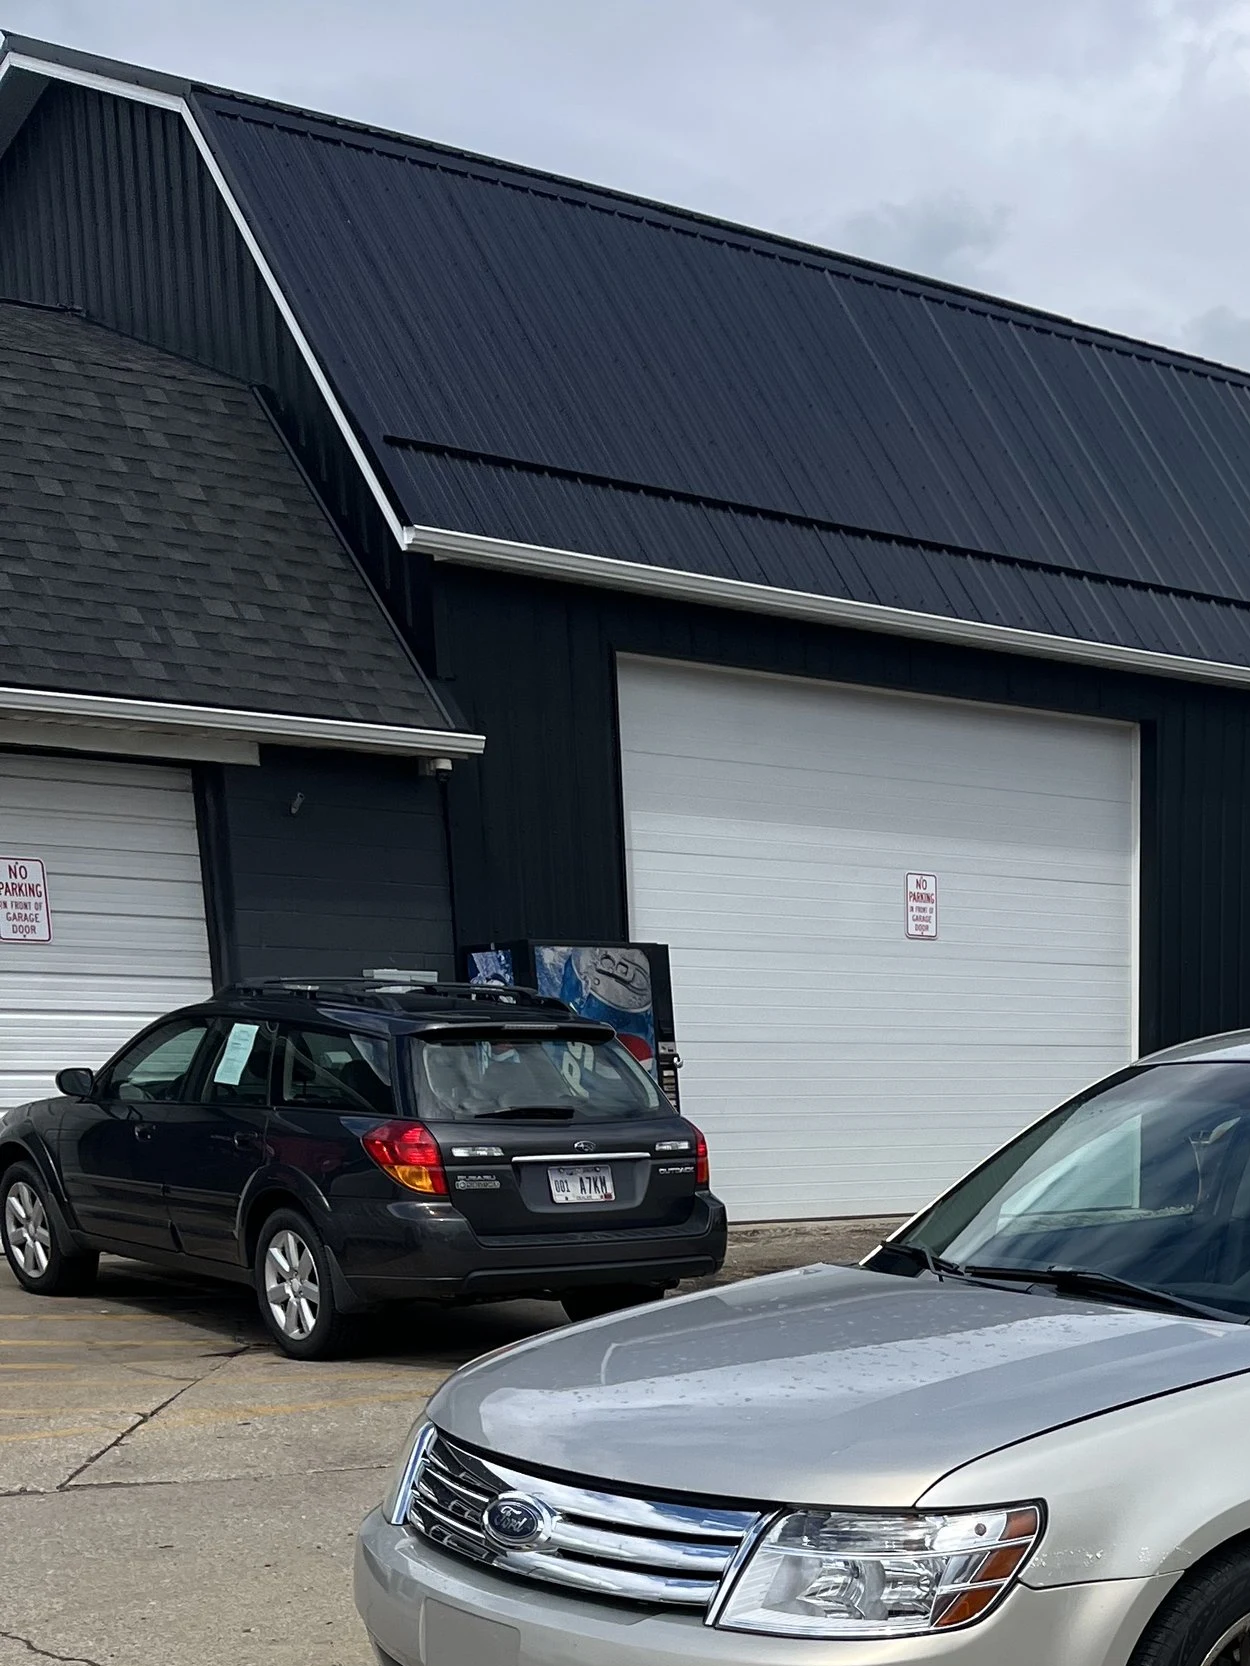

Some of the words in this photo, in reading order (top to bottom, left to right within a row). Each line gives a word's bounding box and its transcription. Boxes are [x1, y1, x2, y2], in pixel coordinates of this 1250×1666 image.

[8, 864, 28, 880] NO
[0, 882, 42, 898] PARKING
[916, 879, 927, 891] NO
[909, 892, 934, 904] PARKING
[10, 901, 32, 911] FRONT
[34, 901, 43, 911] OF
[6, 912, 40, 923] GARAGE
[912, 914, 932, 924] GARAGE
[12, 924, 37, 934] DOOR
[914, 923, 929, 932] DOOR
[554, 1180, 571, 1193] 001
[495, 1505, 527, 1533] Ford
